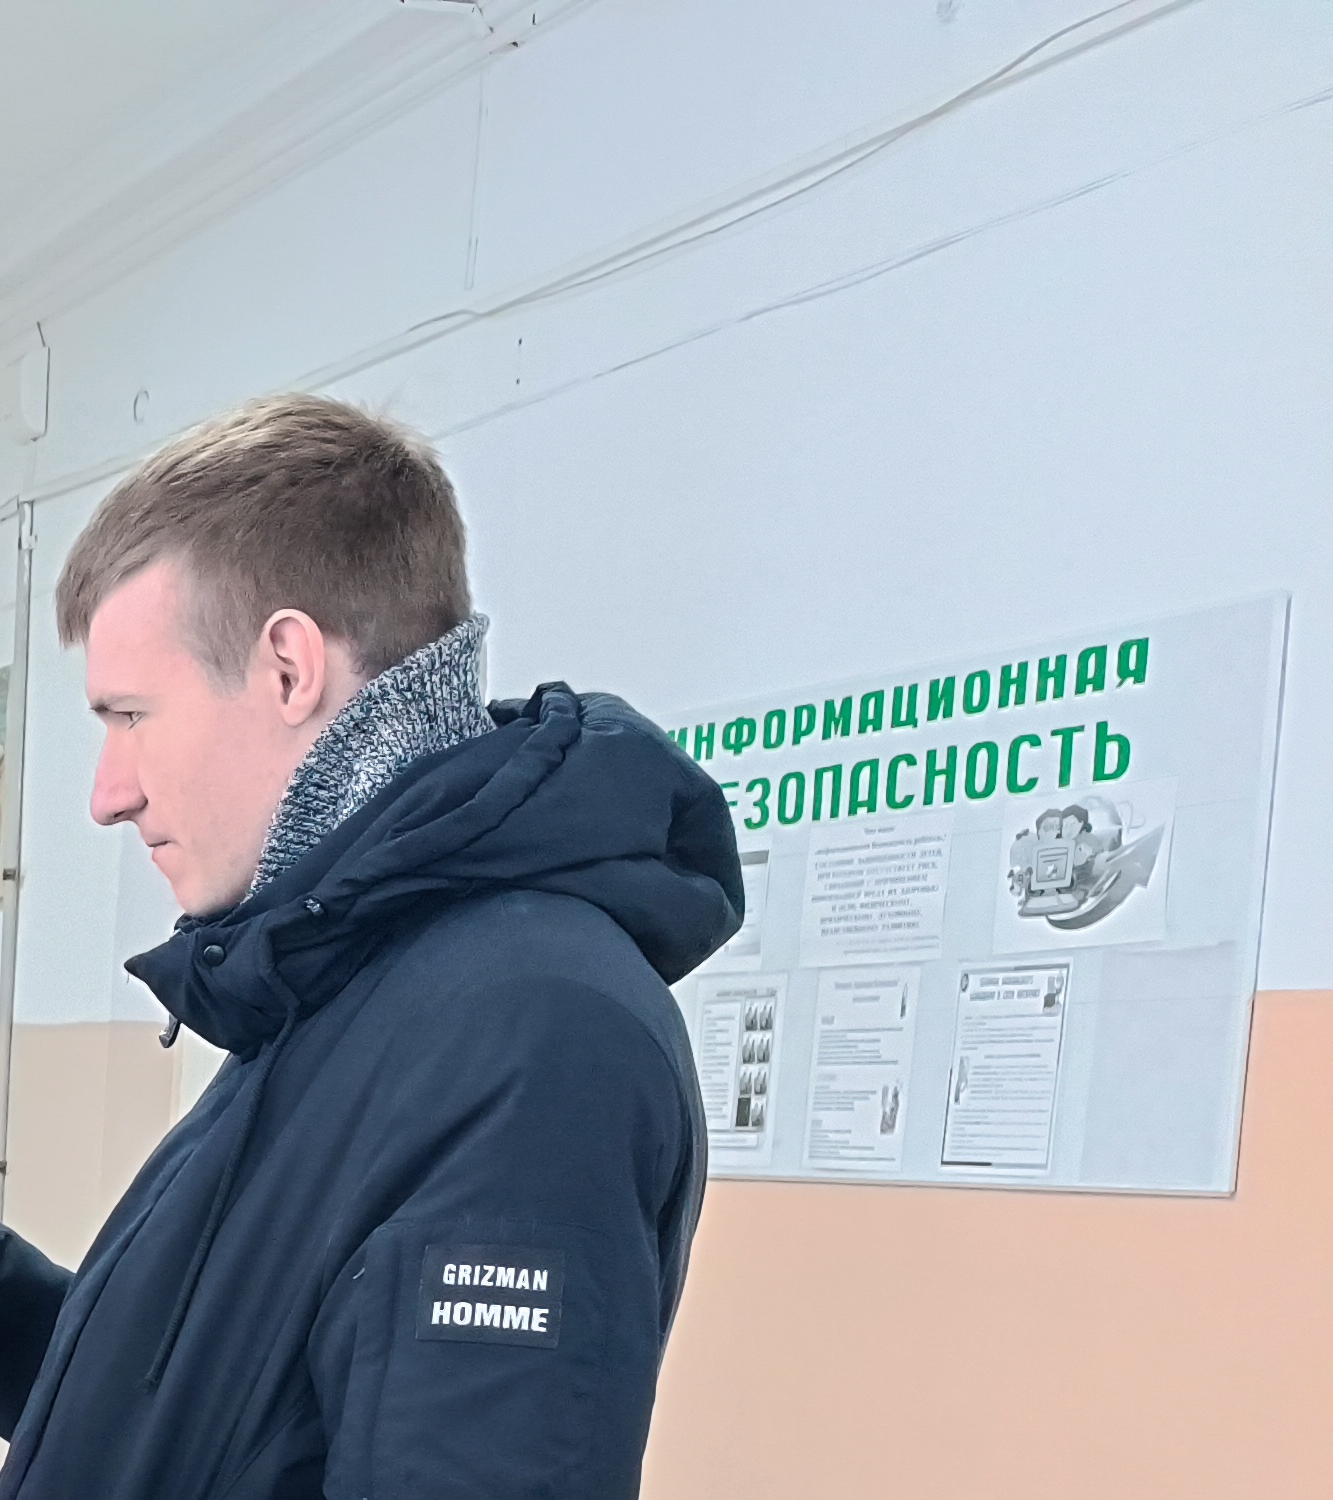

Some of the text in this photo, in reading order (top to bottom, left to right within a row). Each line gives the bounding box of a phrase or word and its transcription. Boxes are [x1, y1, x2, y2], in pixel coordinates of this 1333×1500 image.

[720, 720, 1131, 830] ЗОПАСНОСТЬ
[442, 1263, 549, 1291] GRIZMAN
[431, 1300, 550, 1333] HOMME
